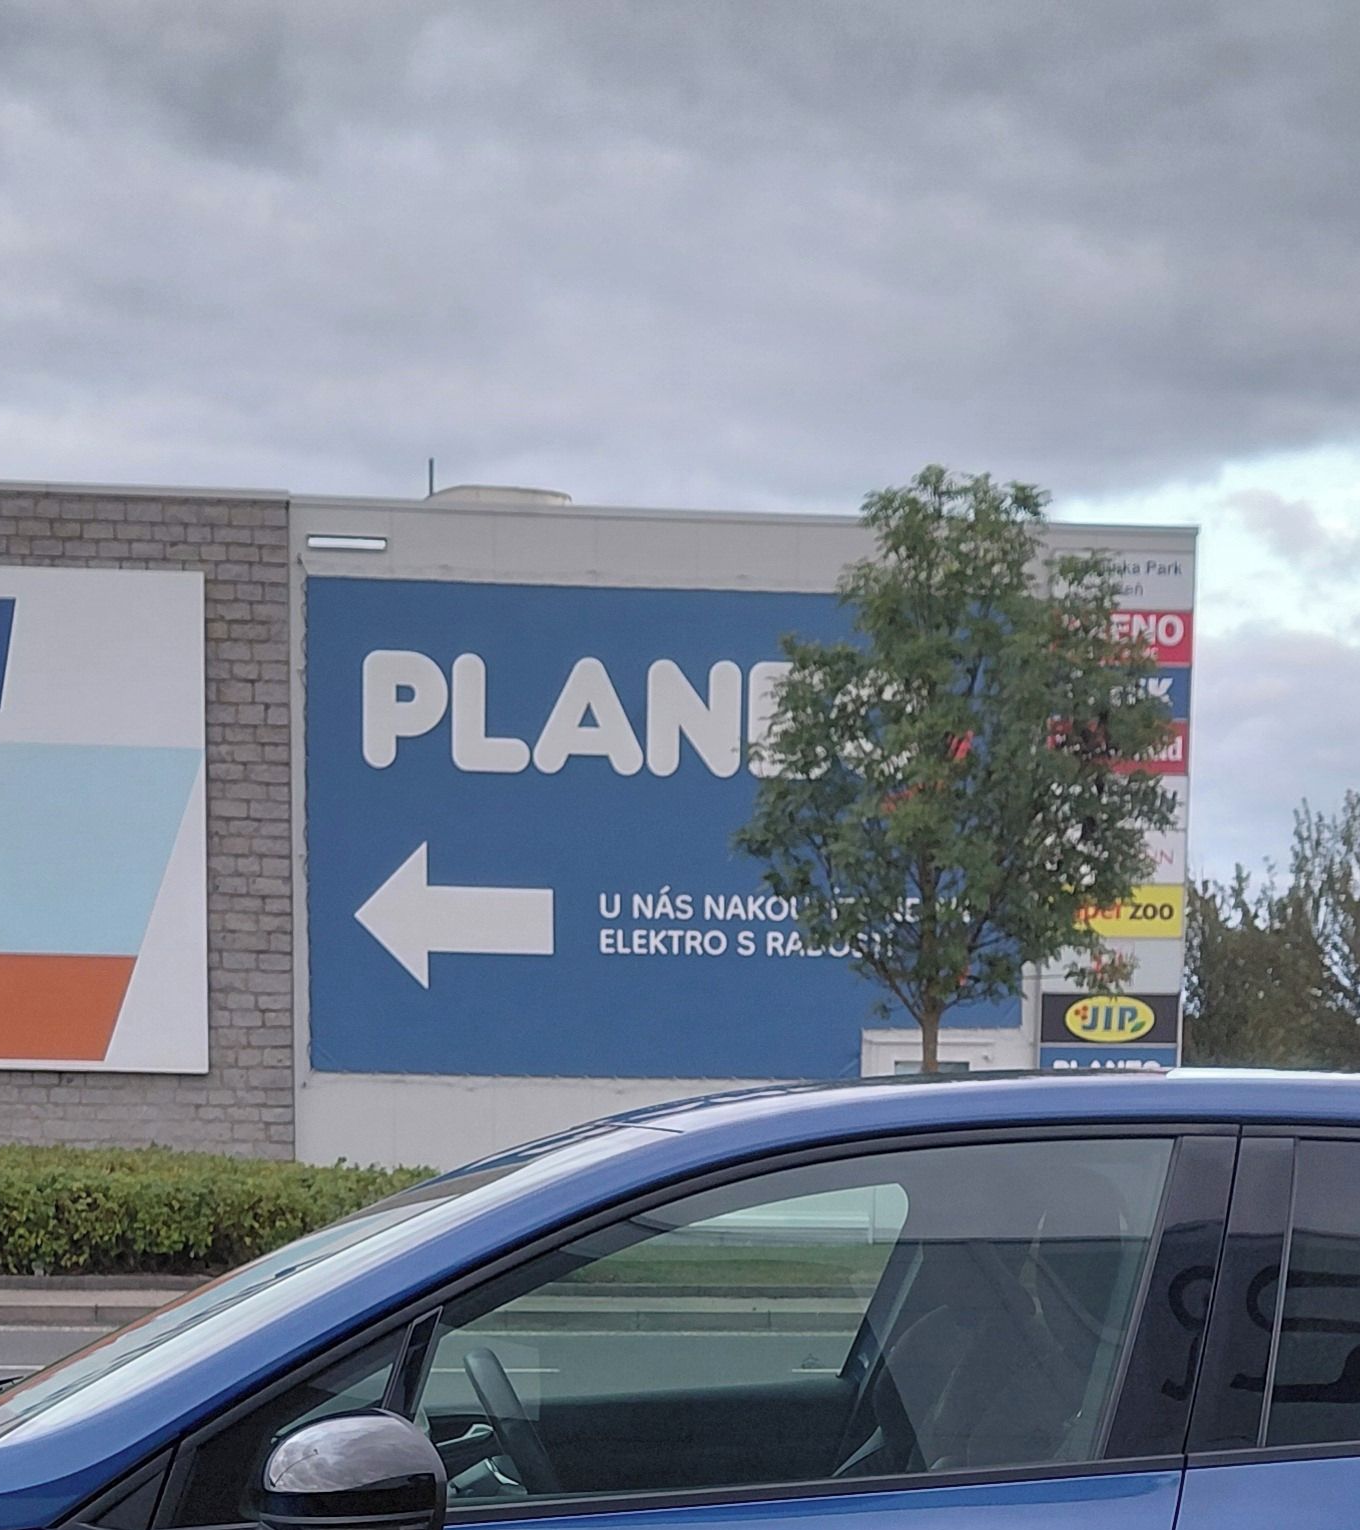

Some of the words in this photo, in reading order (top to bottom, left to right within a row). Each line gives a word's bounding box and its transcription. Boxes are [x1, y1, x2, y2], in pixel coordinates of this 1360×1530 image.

[1146, 559, 1183, 575] Park
[1090, 613, 1185, 647] ENO
[361, 649, 928, 780] PLANE
[599, 893, 621, 919] U
[632, 885, 695, 920] NÁS
[599, 929, 728, 956] ELEKTRO
[736, 930, 756, 957] S
[1081, 1005, 1139, 1032] JIP
